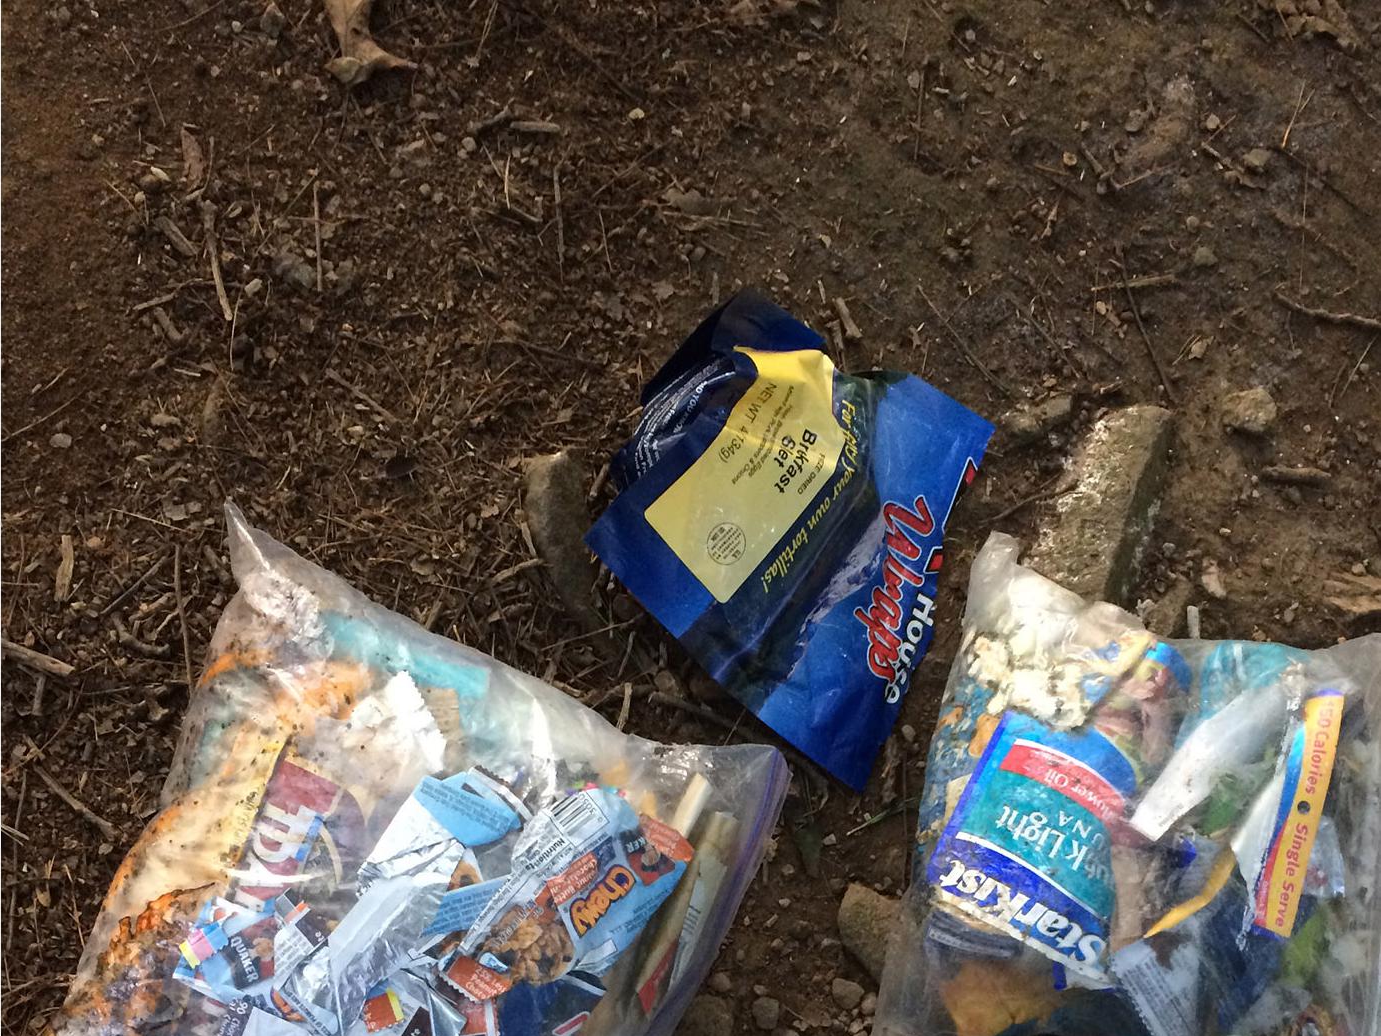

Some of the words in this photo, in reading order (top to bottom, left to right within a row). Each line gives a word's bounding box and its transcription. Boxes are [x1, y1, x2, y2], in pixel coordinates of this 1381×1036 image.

[745, 403, 761, 423] WT
[841, 399, 857, 428] For
[832, 457, 856, 501] your
[807, 496, 831, 530] own
[760, 527, 809, 593] tortillas!
[853, 494, 936, 684] Wraps
[1045, 769, 1069, 789] Oil
[1304, 730, 1330, 796] Calories
[996, 804, 1067, 860] Light
[1285, 822, 1309, 878] Single
[570, 864, 637, 939] Chewy
[939, 858, 1107, 966] StarKist
[1275, 879, 1295, 929] Serve
[230, 935, 260, 984] QUAKER
[236, 1000, 248, 1015] 90
